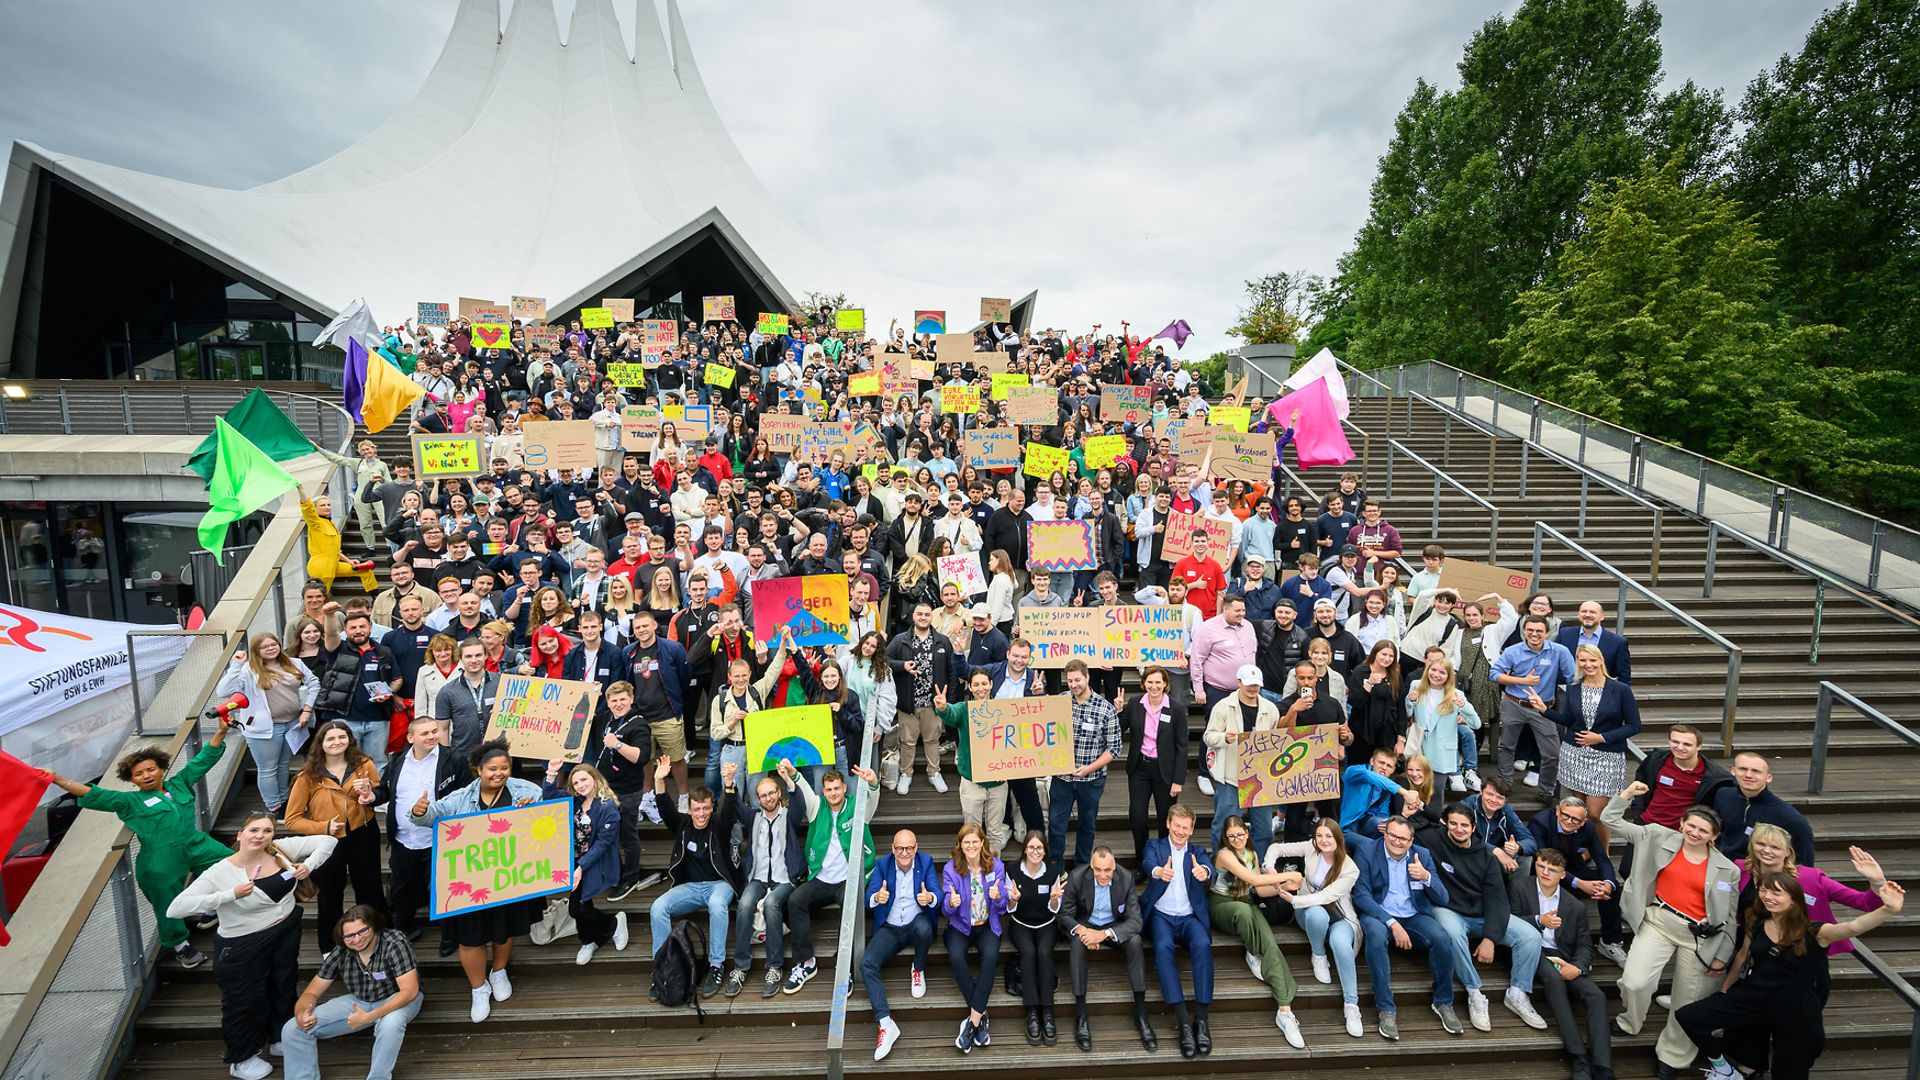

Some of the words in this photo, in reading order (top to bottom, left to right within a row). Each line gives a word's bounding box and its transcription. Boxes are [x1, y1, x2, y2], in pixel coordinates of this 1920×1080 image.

[660, 321, 674, 331] NO
[656, 332, 675, 342] HATE
[803, 427, 820, 436] Wer
[1167, 420, 1186, 428] ALLE
[982, 441, 994, 455] S1
[1167, 513, 1186, 531] Mit
[1203, 518, 1226, 537] Bahn
[1031, 612, 1050, 620] WIR
[1052, 611, 1071, 620] SIND
[1105, 608, 1150, 627] SCHAU
[1153, 607, 1182, 622] NICHT
[1038, 642, 1070, 659] TRAU
[1073, 643, 1096, 657] DICH
[1103, 648, 1136, 661] WIRDS
[28, 651, 128, 695] STIFTUNGSFAMILIE
[64, 684, 81, 701] BSW
[82, 682, 88, 692] &
[89, 676, 105, 690] EWH
[499, 698, 530, 715] STATT
[1011, 700, 1045, 716] Jetzt
[992, 721, 1068, 750] FRIEDEN
[443, 835, 517, 880] TRAU
[493, 859, 550, 891] DICH
